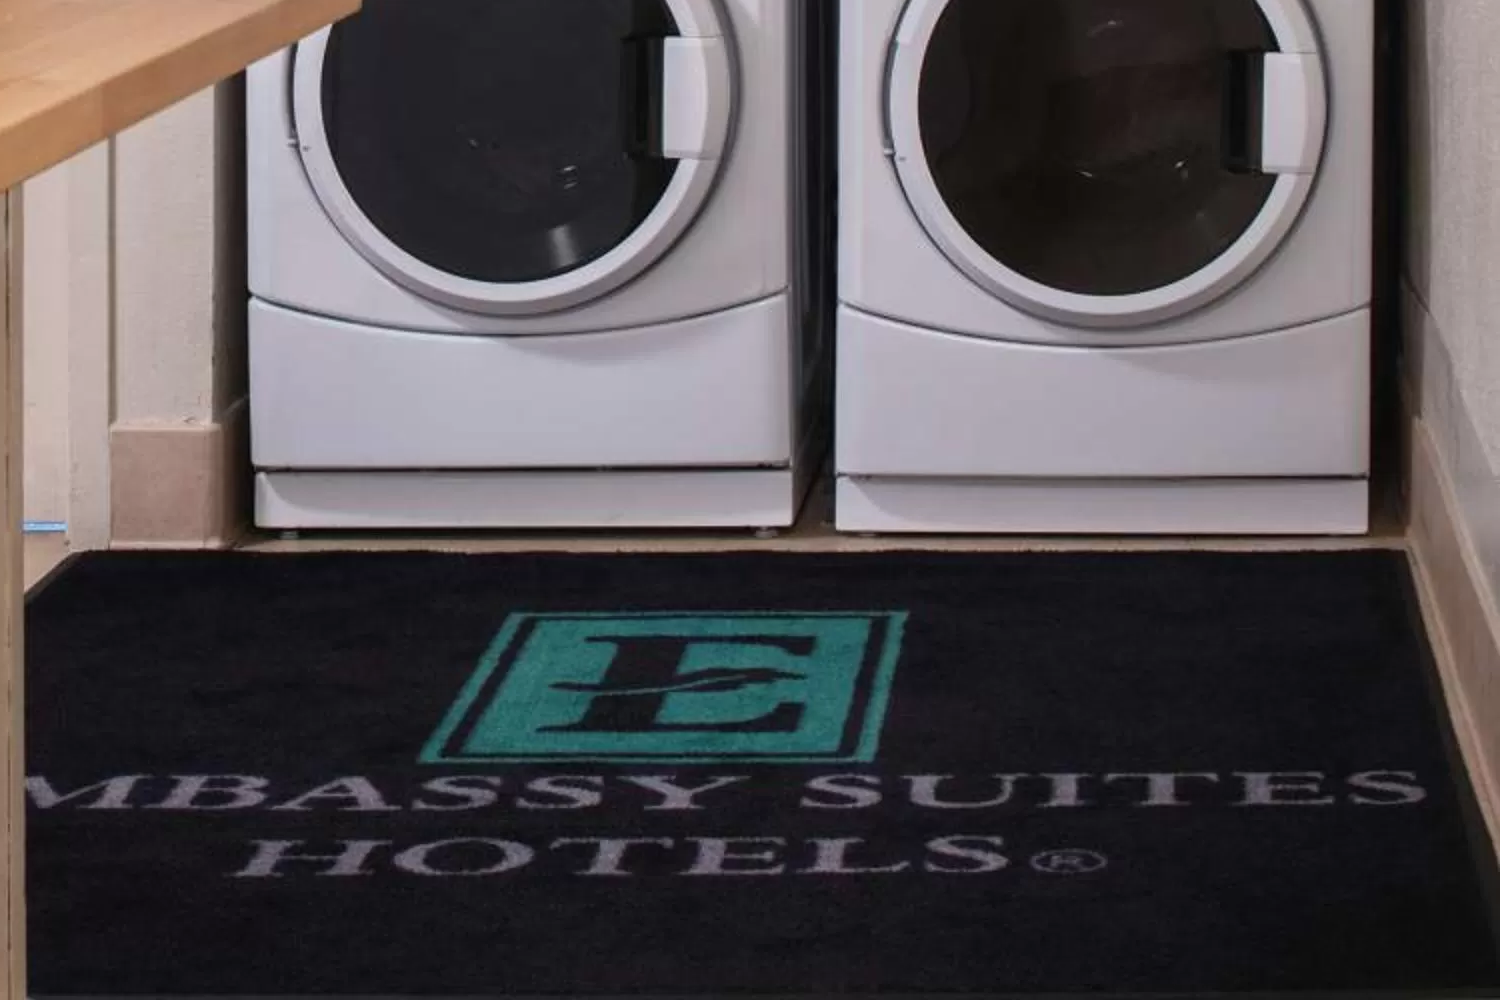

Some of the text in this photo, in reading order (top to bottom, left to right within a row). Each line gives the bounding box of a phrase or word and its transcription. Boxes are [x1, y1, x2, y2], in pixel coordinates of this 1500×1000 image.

[25, 770, 1427, 812] MBASSY SUITES
[228, 834, 1009, 878] HOTELS
